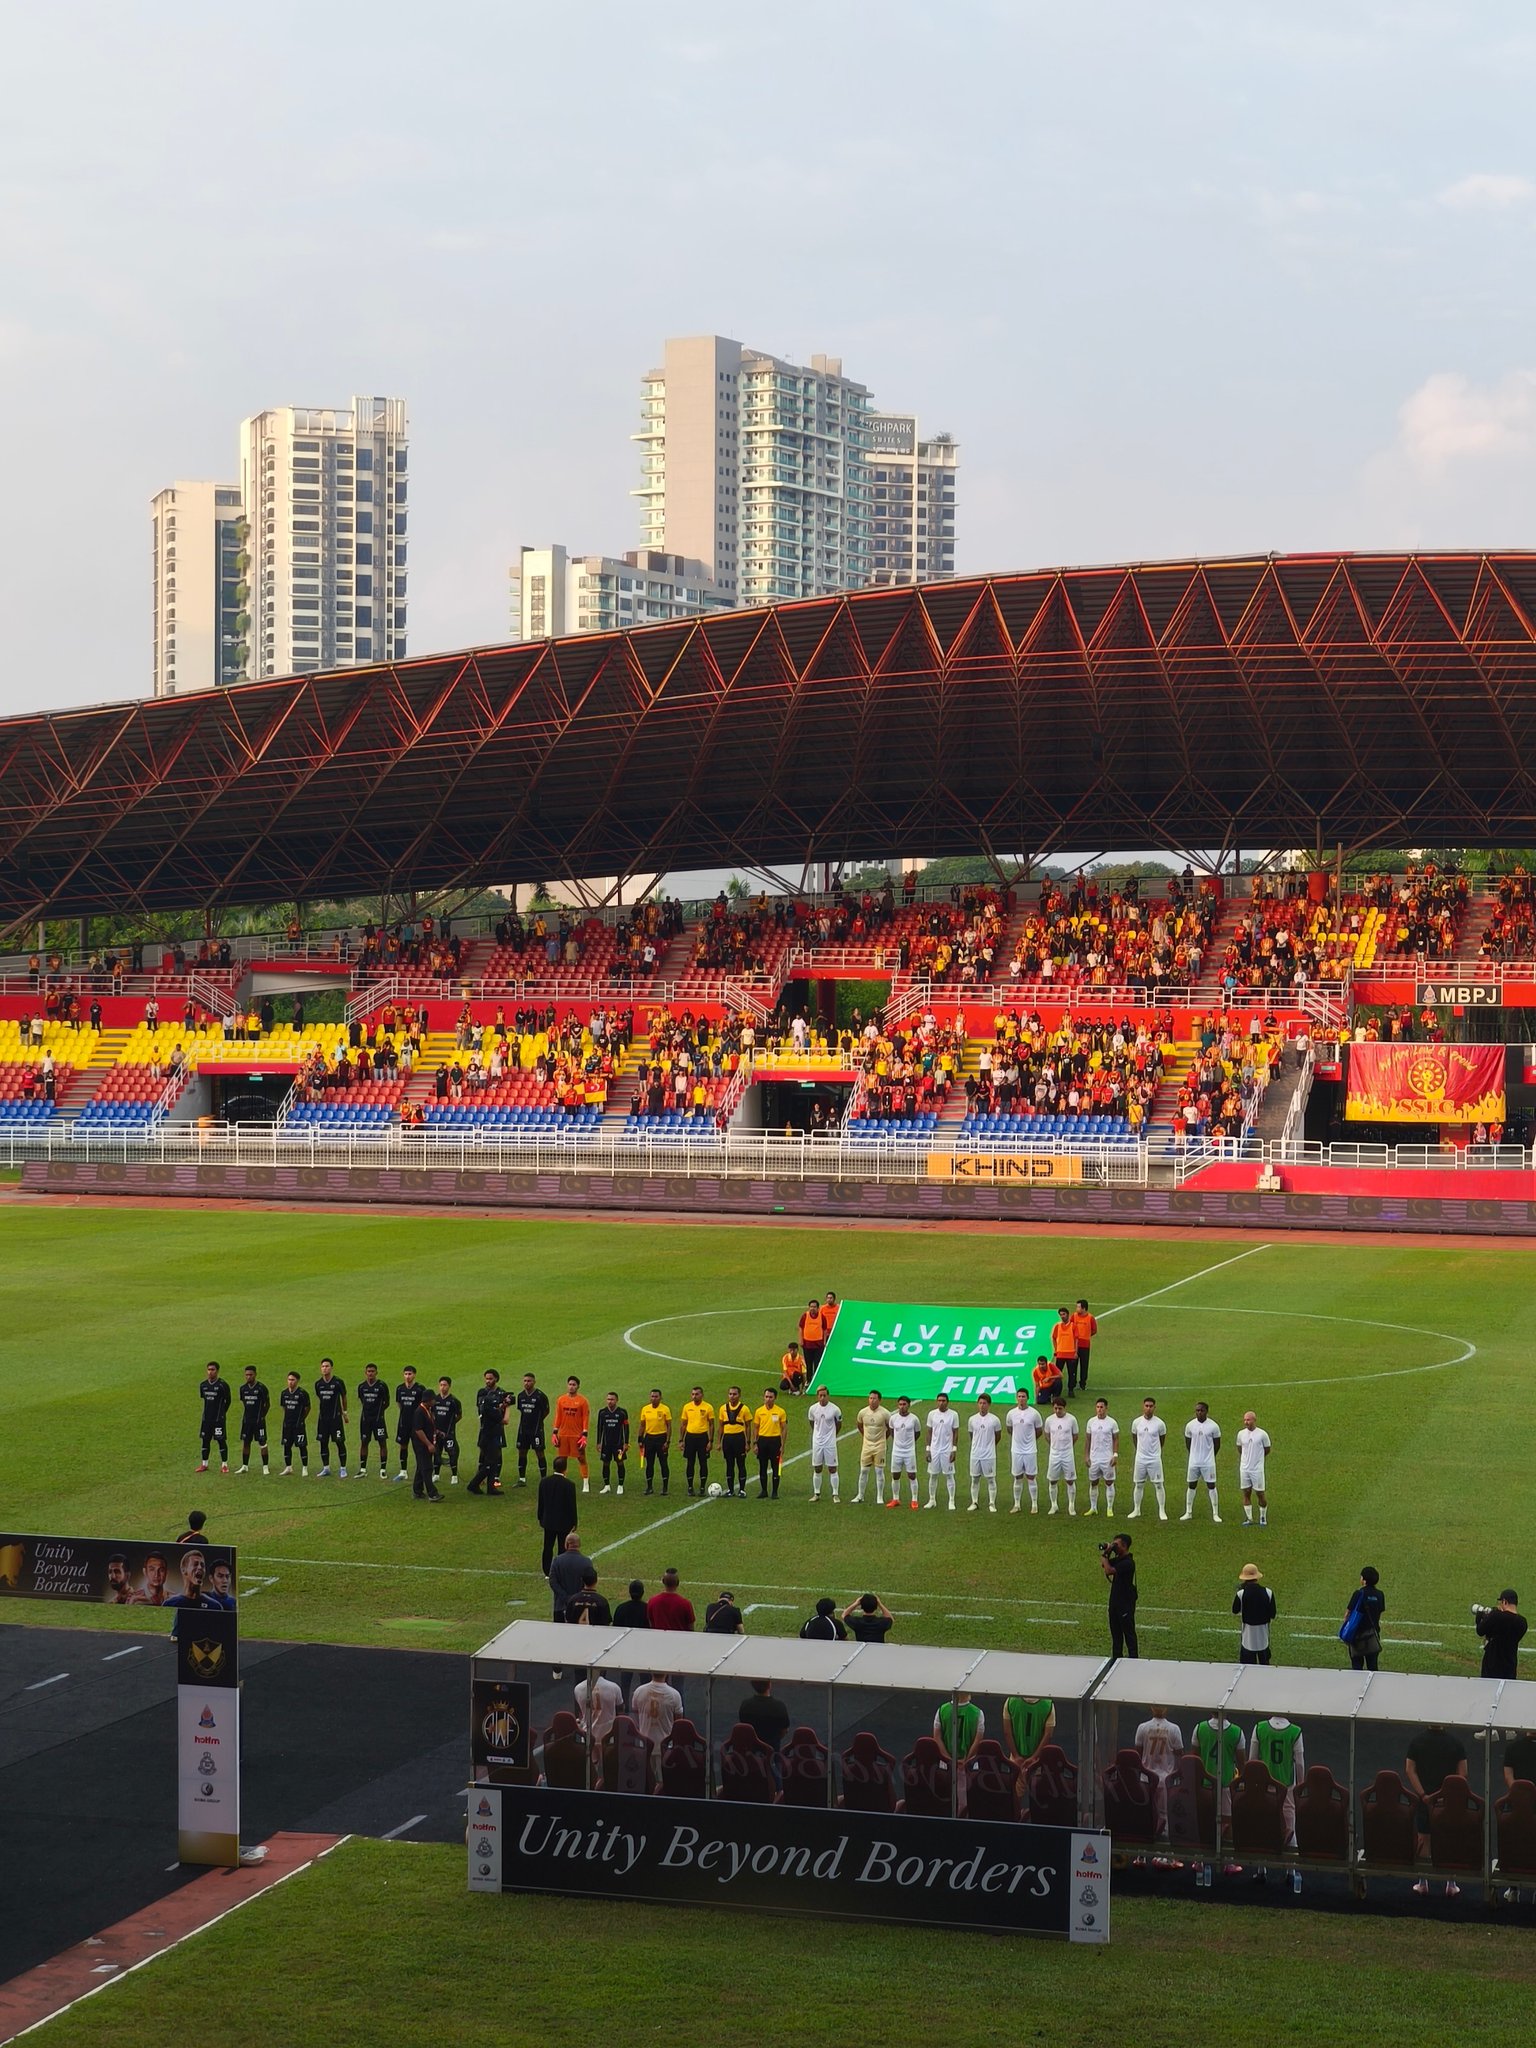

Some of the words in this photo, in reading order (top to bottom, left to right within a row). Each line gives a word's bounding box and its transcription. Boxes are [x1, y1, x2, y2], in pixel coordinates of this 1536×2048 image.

[1440, 987, 1497, 1003] MBPJ
[950, 1157, 1054, 1178] KHIND
[862, 1320, 1037, 1341] LIVING
[855, 1336, 1029, 1357] FOOTBALL
[941, 1375, 1017, 1395] FIFA
[336, 1430, 341, 1438] 2
[34, 1542, 74, 1563] Unity
[33, 1559, 89, 1579] Beyond
[33, 1576, 90, 1594] Borders
[1270, 1739, 1284, 1765] 6
[518, 1814, 647, 1875] Unity
[658, 1825, 849, 1883] Beyond
[854, 1840, 1057, 1897] Borders
